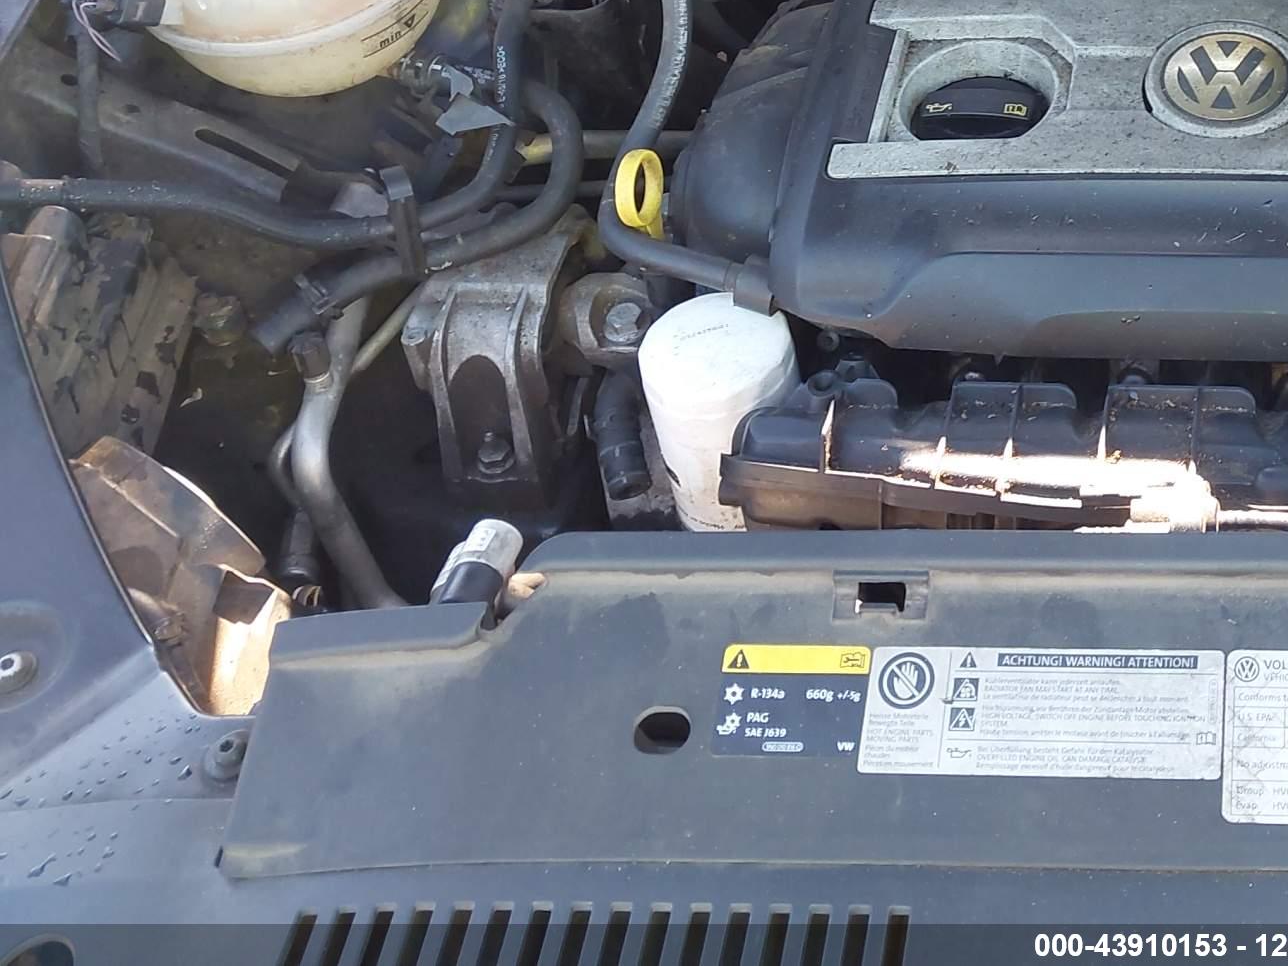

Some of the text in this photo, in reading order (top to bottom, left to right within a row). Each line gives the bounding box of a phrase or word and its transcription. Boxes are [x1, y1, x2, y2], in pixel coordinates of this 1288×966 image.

[379, 30, 402, 47] min
[1002, 655, 1195, 668] ACHTUNG! WARNING! ATTENTION!
[751, 688, 785, 699] R-134a
[806, 689, 834, 702] 660g
[746, 712, 769, 723] PAG
[744, 727, 787, 739] SAE J639
[837, 741, 856, 751] VW
